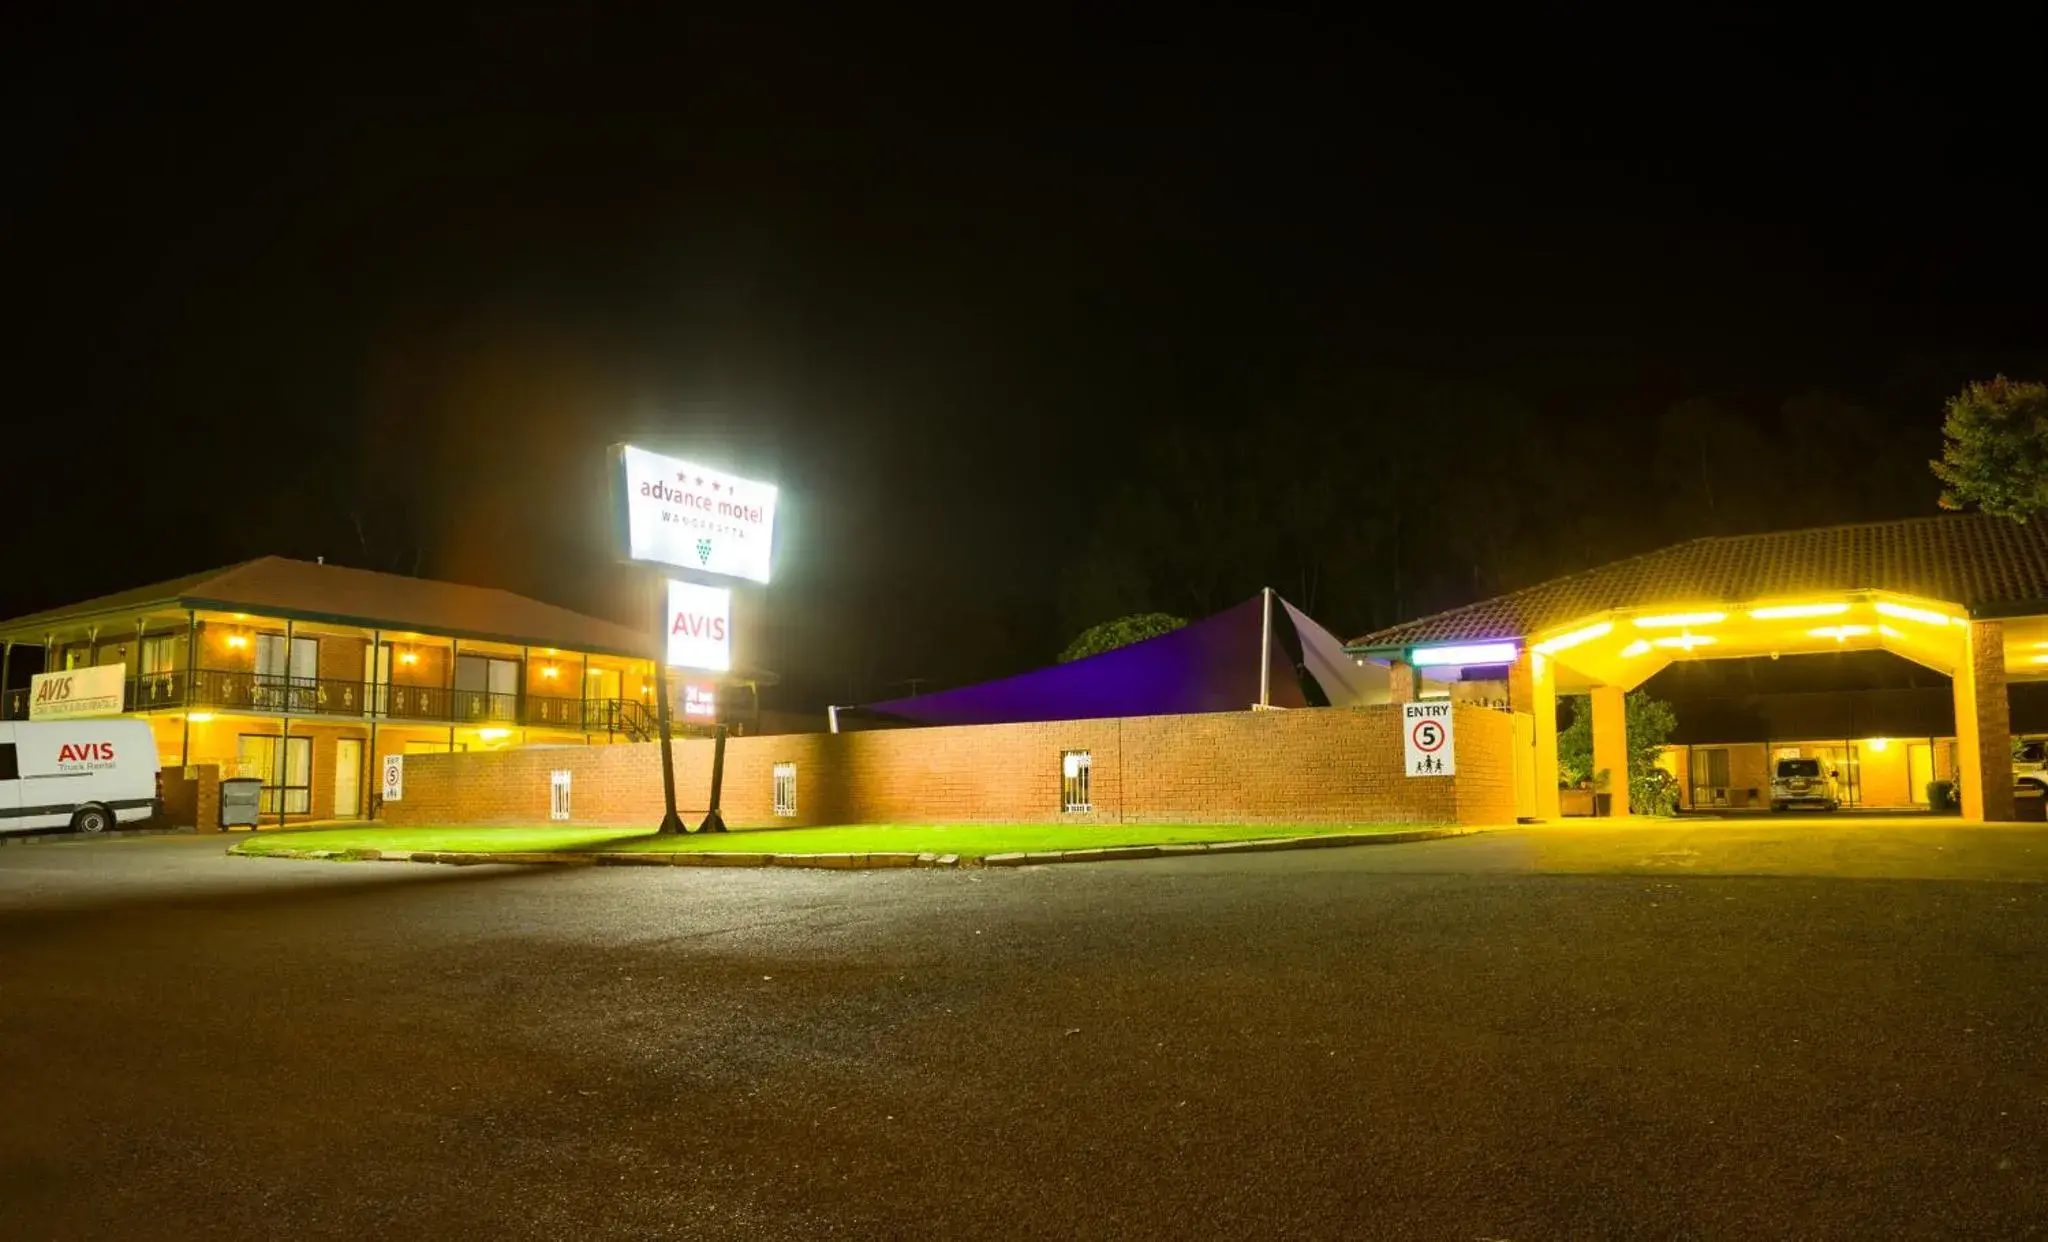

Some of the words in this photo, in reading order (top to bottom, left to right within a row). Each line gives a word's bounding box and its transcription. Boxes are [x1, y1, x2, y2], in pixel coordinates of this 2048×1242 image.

[641, 480, 712, 512] advance
[718, 502, 763, 523] motel
[672, 611, 725, 642] AVIS
[36, 676, 73, 701] AVIS
[1406, 705, 1449, 718] ENTRY
[1422, 726, 1436, 746] 5
[57, 742, 114, 763] AVIS
[58, 762, 84, 772] Truck
[87, 761, 116, 771] Rental
[390, 770, 396, 782] 5
